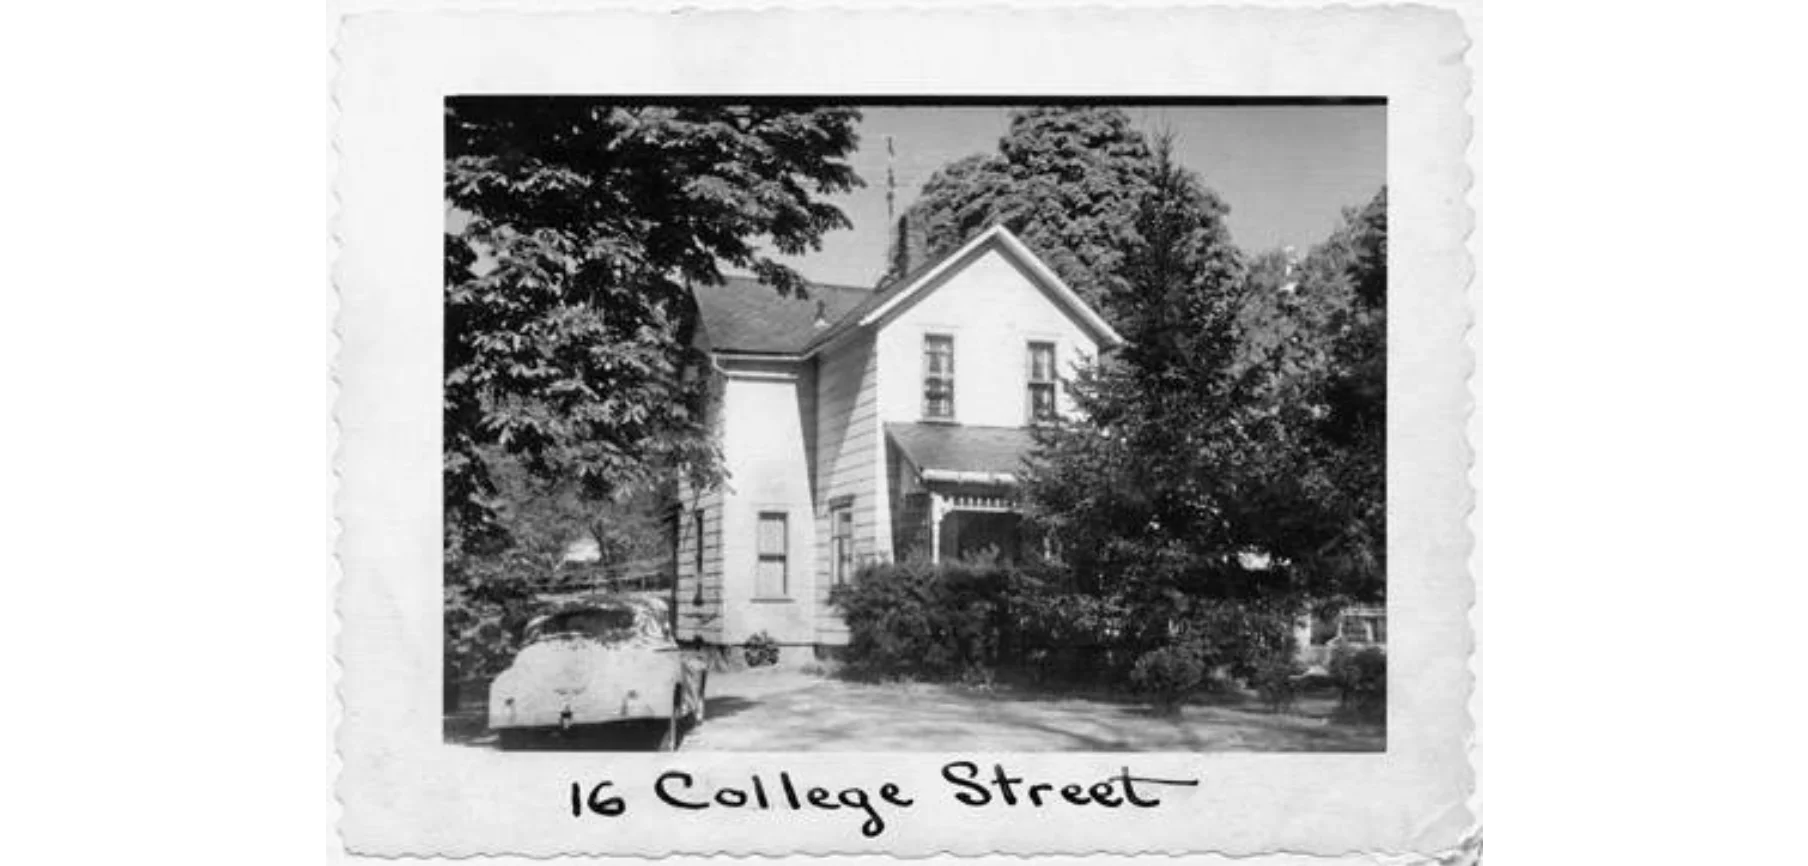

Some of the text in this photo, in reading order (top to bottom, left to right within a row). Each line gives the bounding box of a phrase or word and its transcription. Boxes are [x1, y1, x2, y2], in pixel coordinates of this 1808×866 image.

[570, 760, 1200, 838] 16 College Street
